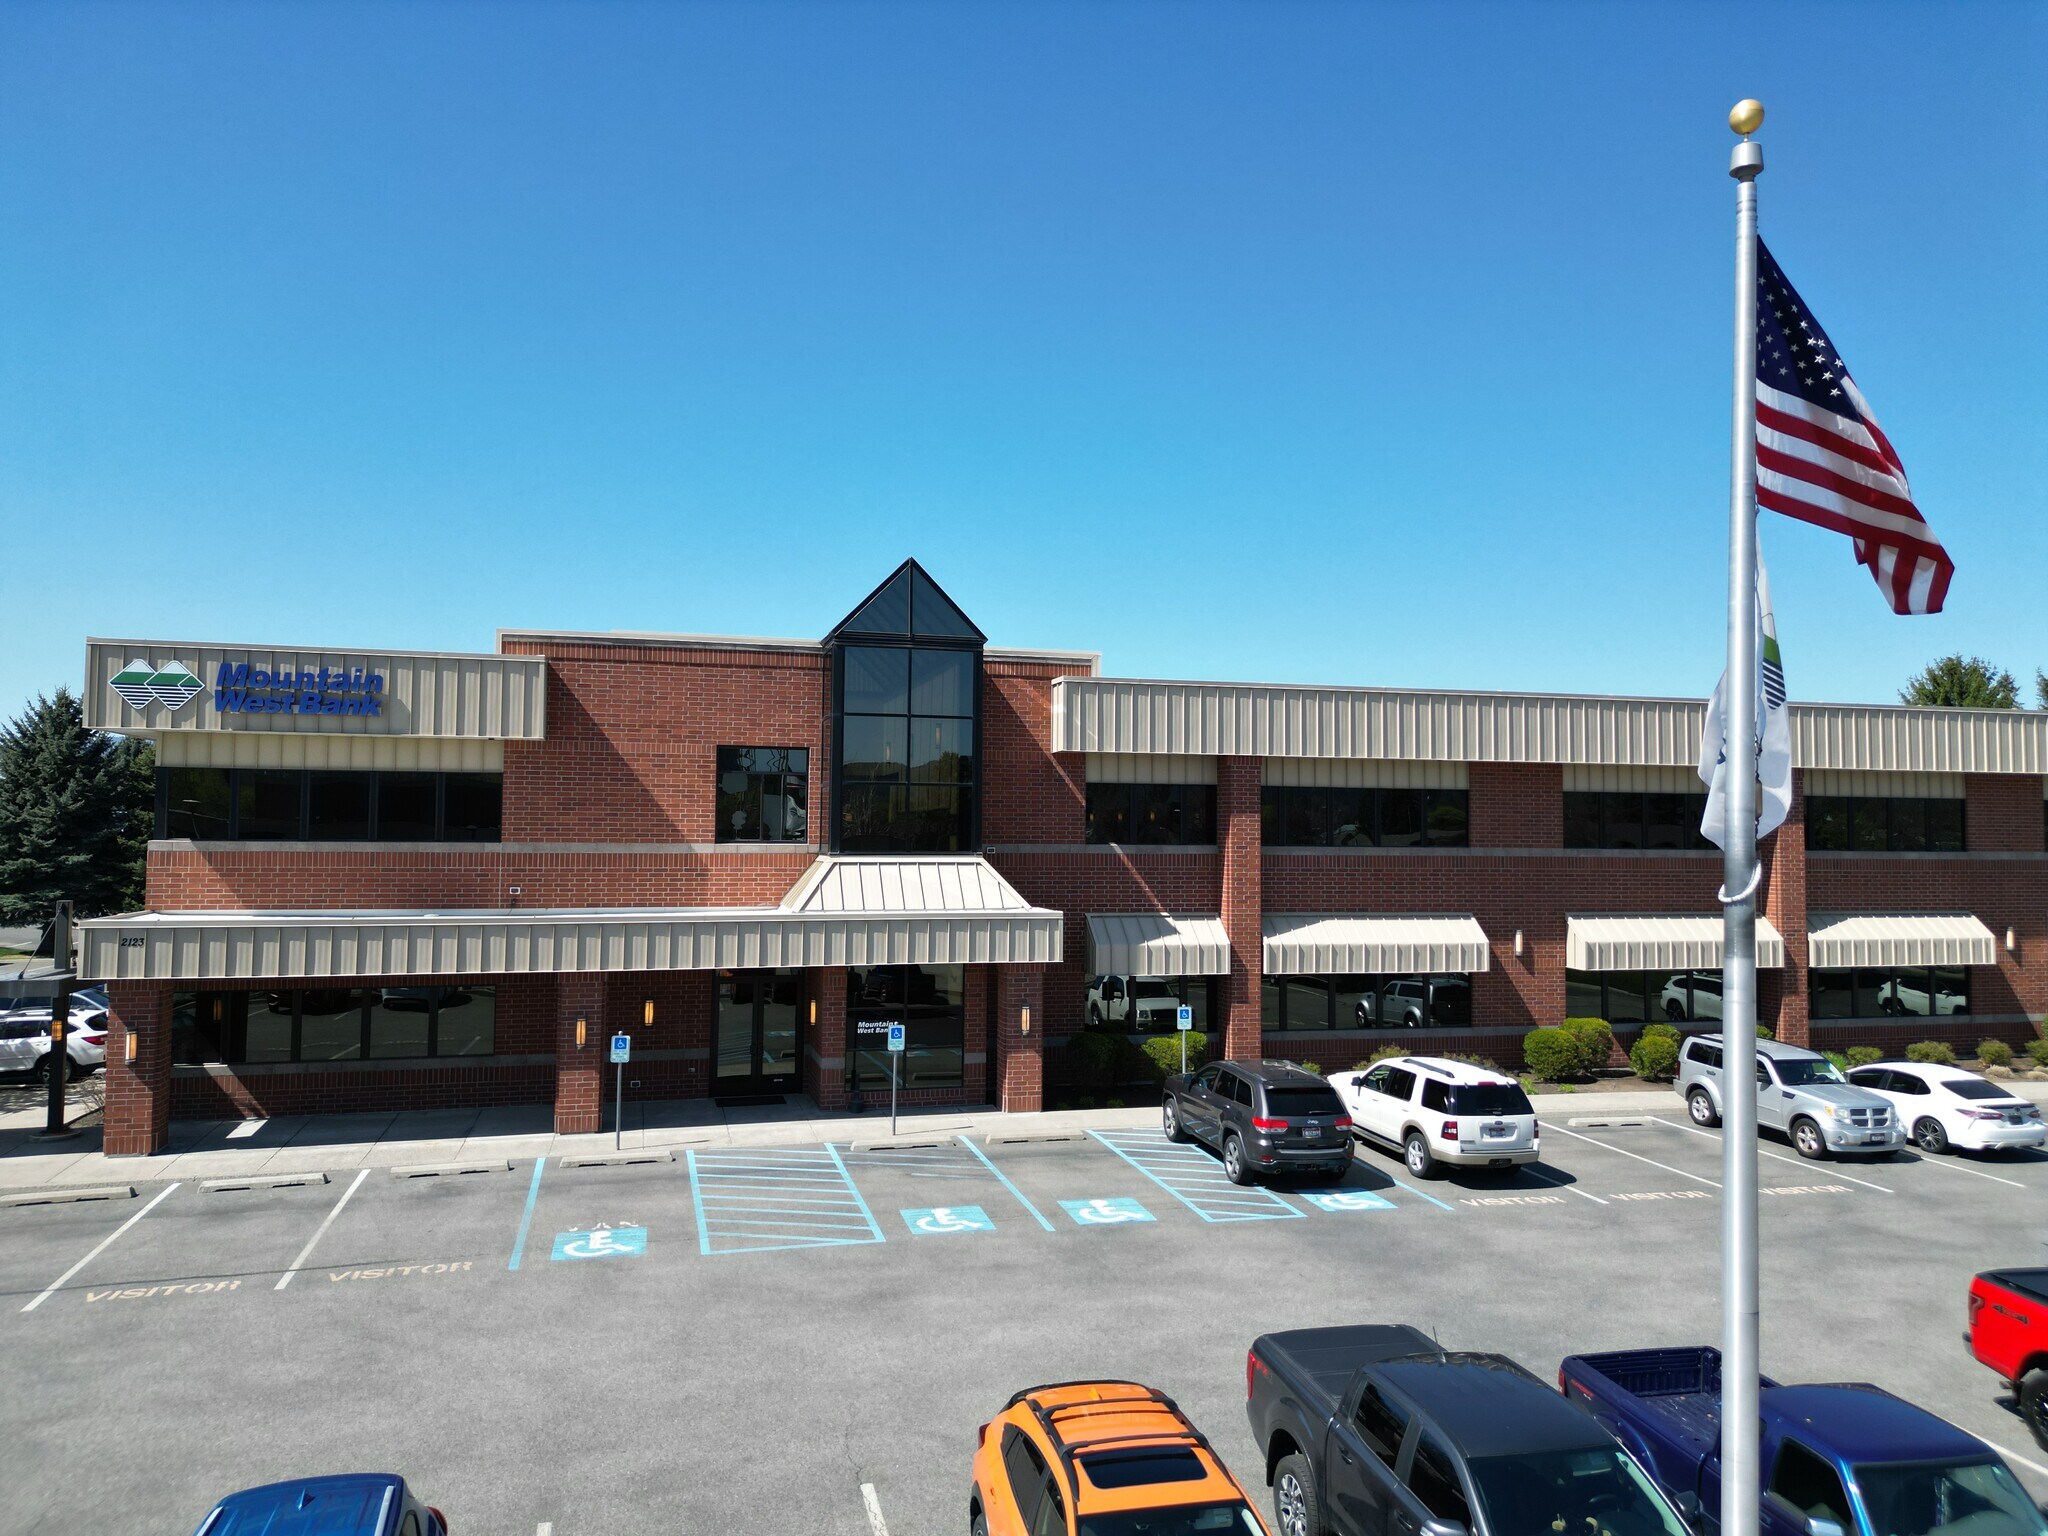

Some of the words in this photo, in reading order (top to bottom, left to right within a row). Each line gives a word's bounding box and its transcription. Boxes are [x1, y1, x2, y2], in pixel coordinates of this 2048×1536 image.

[216, 663, 384, 693] Mountain
[214, 689, 295, 714] West
[299, 692, 381, 717] Bank
[120, 937, 145, 947] 2123
[1608, 1190, 1713, 1201] VISITOR
[1757, 1185, 1854, 1195] VISITOR
[1459, 1195, 1567, 1207] VISITOR
[328, 1261, 473, 1282] VISITOR
[85, 1280, 242, 1303] VISITOR
